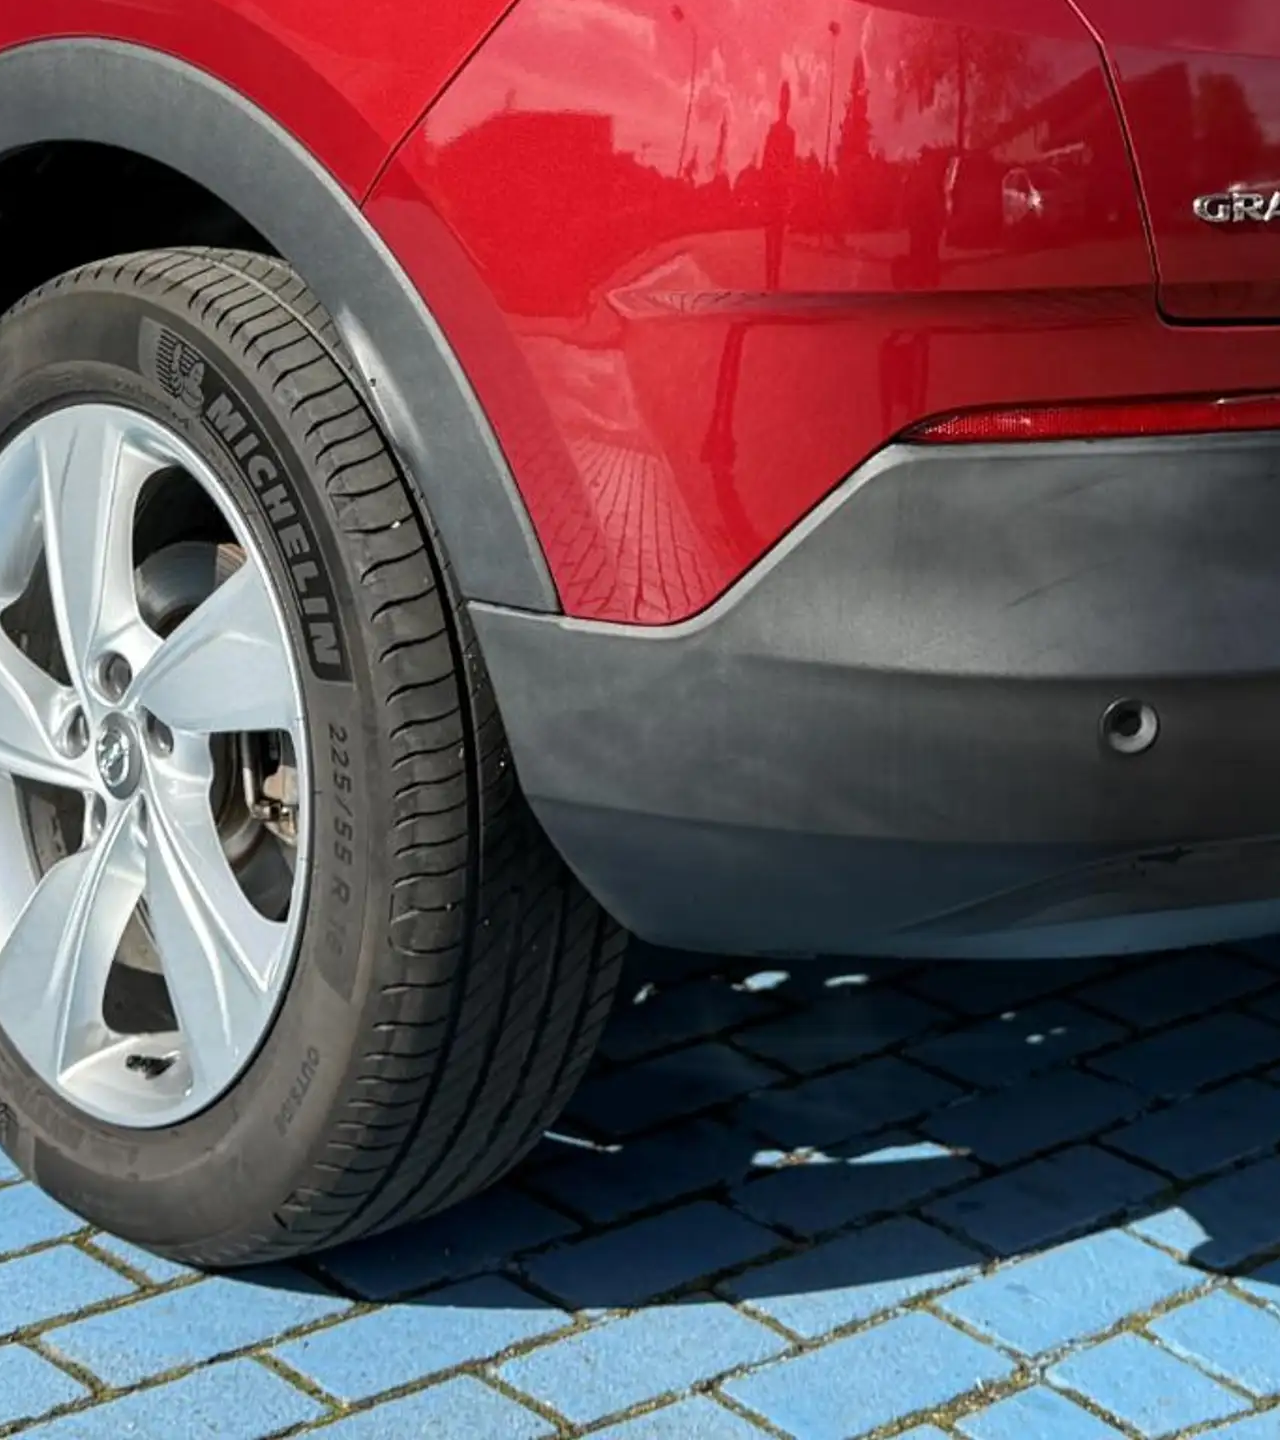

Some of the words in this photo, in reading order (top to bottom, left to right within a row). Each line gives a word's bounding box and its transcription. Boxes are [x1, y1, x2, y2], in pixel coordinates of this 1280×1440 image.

[205, 393, 342, 665] MICHELIN
[328, 722, 354, 866] 225/55
[330, 874, 352, 906] R
